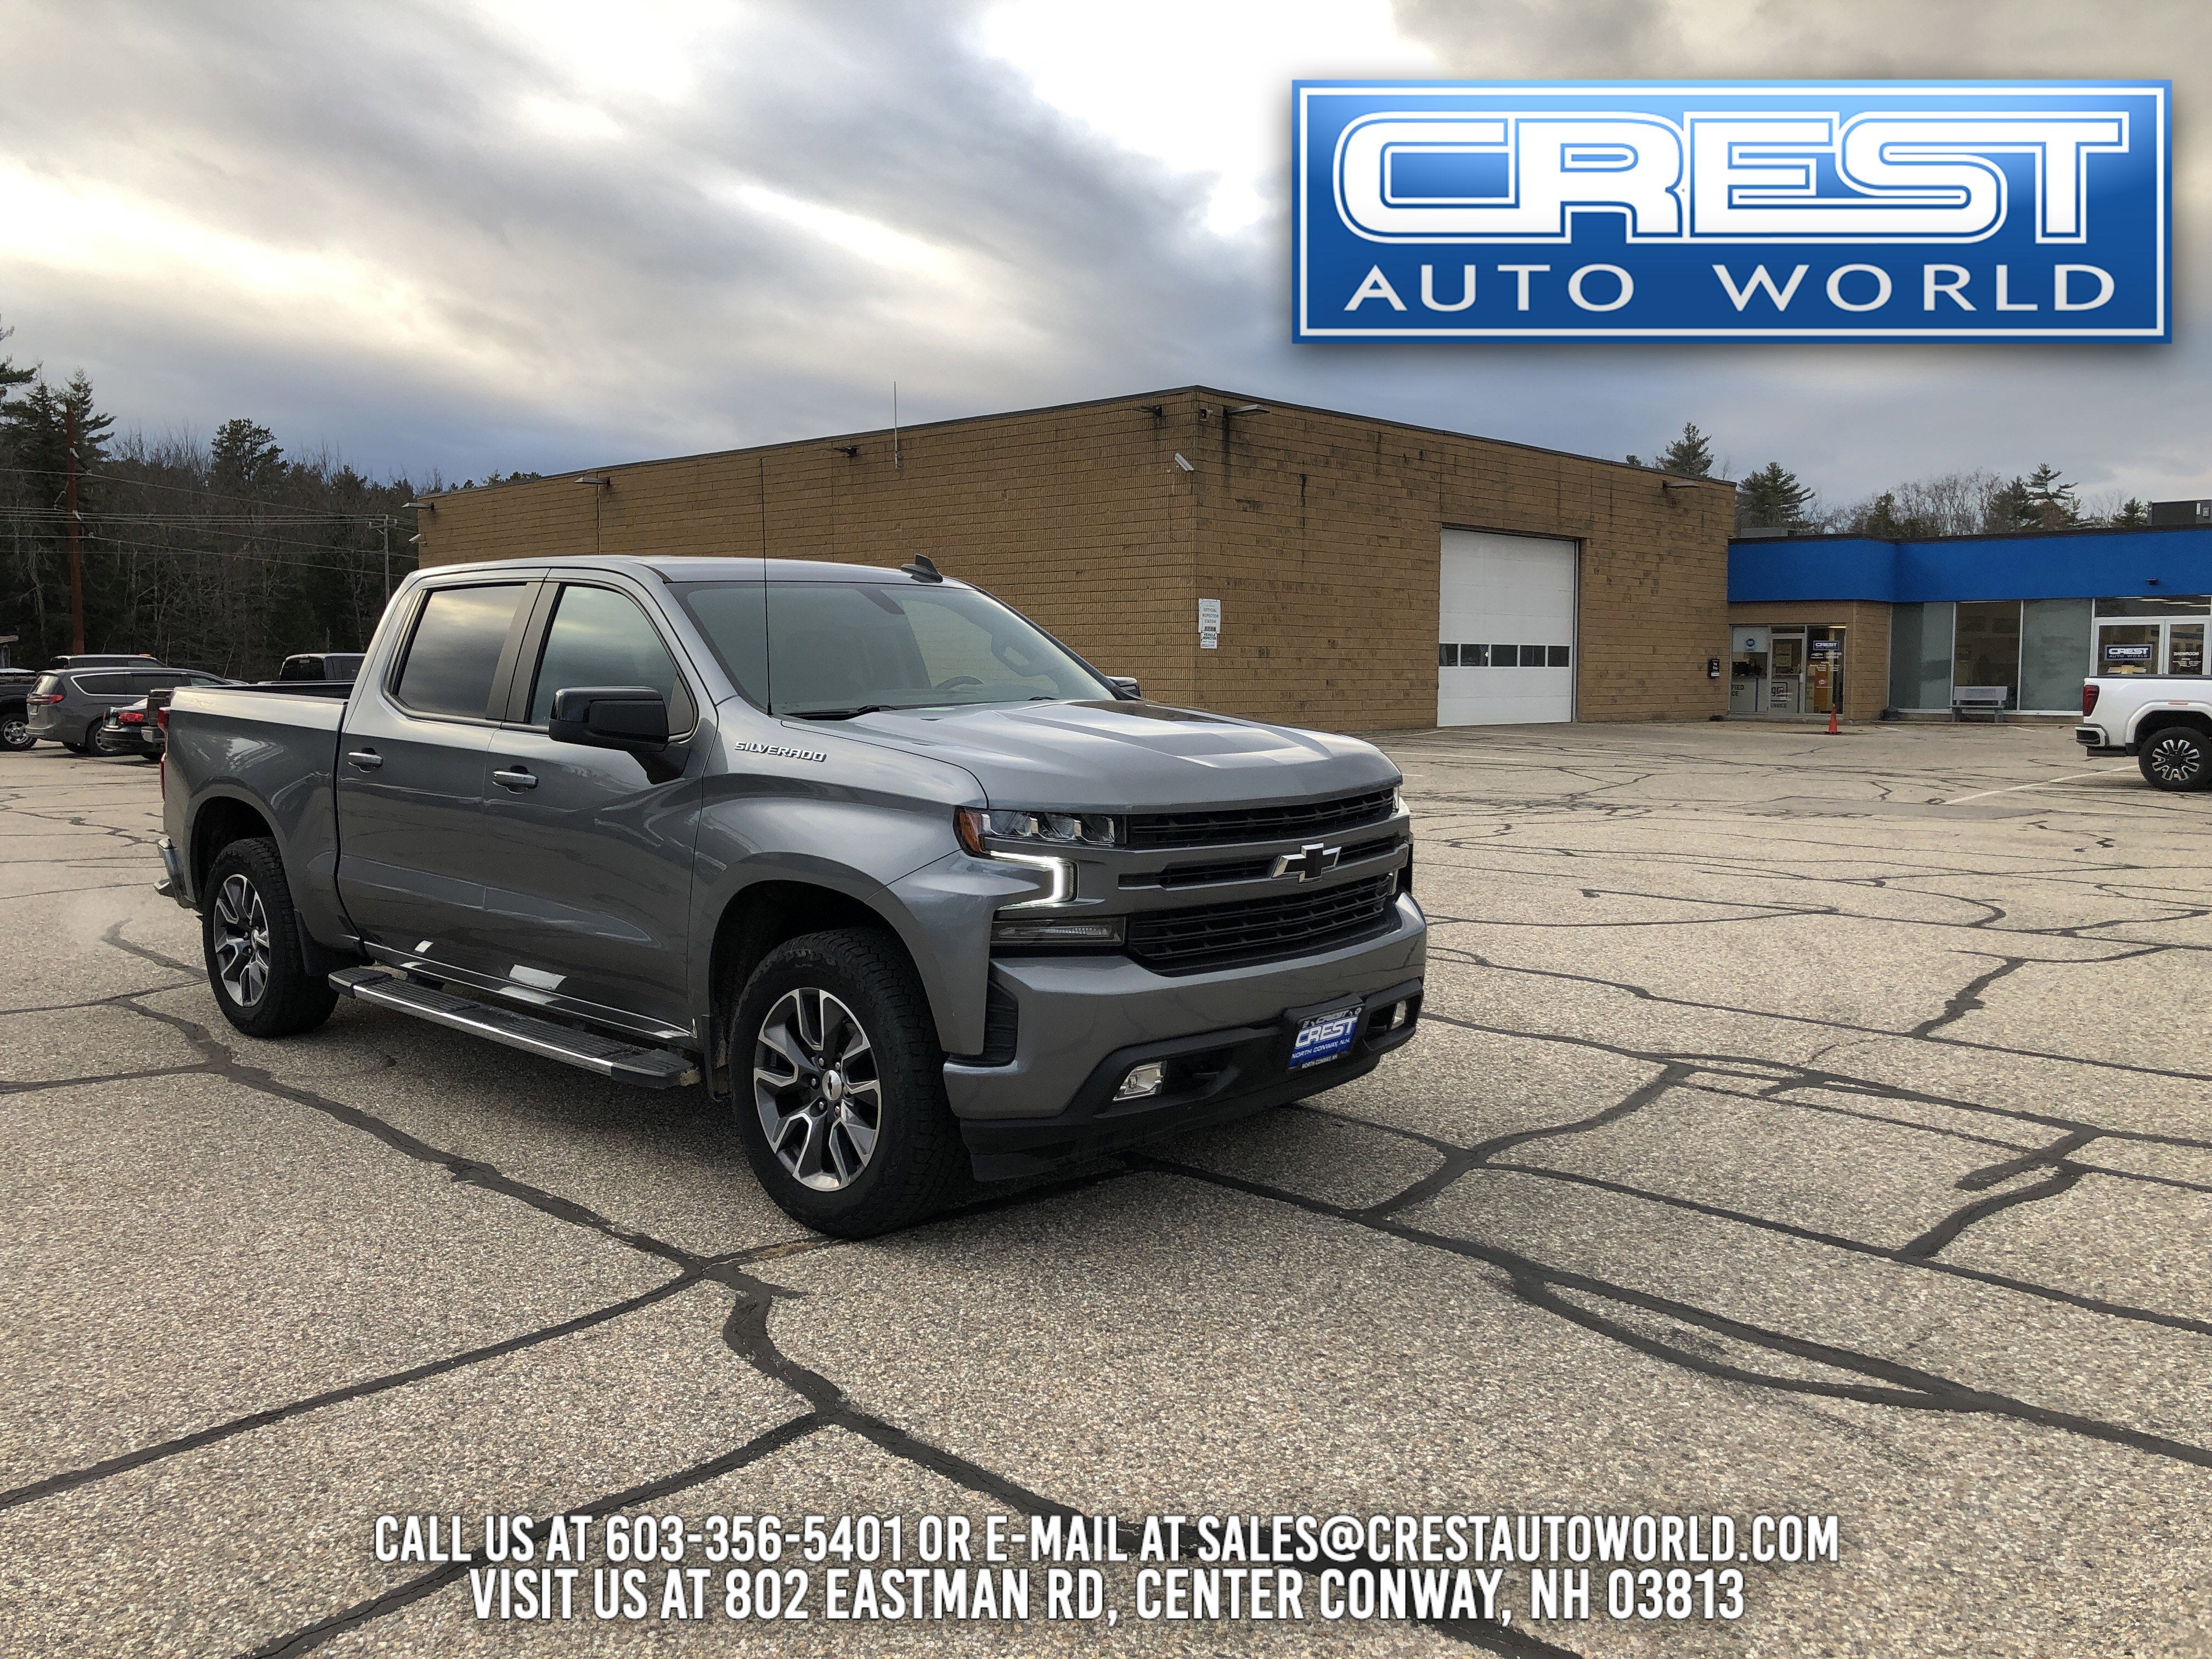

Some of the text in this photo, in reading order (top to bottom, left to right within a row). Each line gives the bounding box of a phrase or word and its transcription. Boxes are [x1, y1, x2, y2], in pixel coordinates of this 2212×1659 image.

[734, 741, 827, 763] SILVERADO
[1295, 1016, 1358, 1048] CREST
[1291, 1048, 1312, 1059] NORTH
